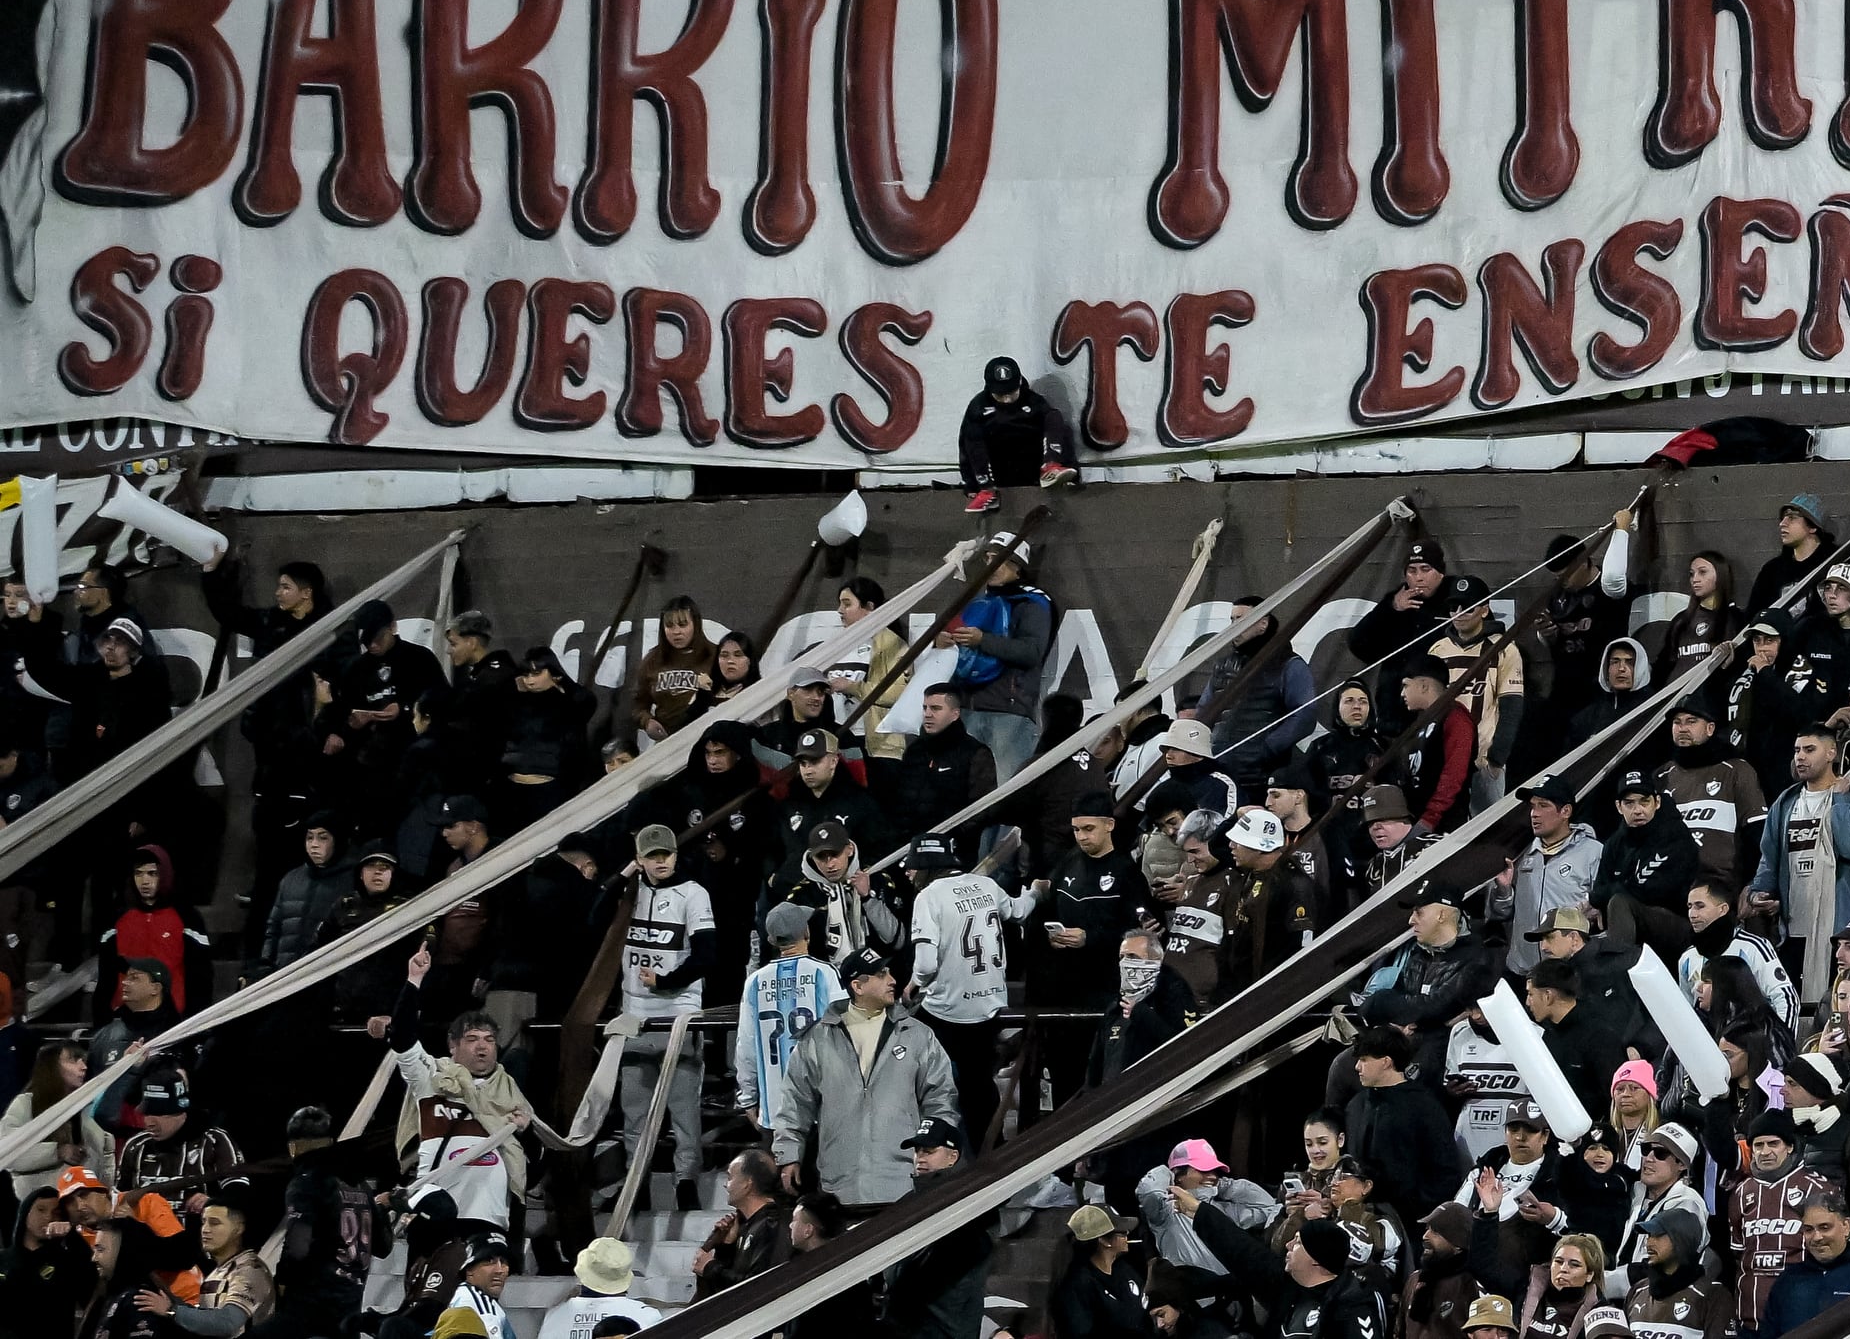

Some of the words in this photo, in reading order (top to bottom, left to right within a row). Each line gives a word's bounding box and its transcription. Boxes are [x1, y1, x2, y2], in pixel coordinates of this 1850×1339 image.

[298, 266, 935, 455] QUERES
[1050, 288, 1259, 454] TE
[1262, 819, 1277, 835] 79
[952, 883, 982, 896] CIVILE
[955, 893, 995, 914] RETAMAR
[961, 910, 1006, 976] 43
[628, 951, 664, 969] pax
[1473, 1110, 1500, 1121] TRF
[1754, 1254, 1783, 1267] TRF
